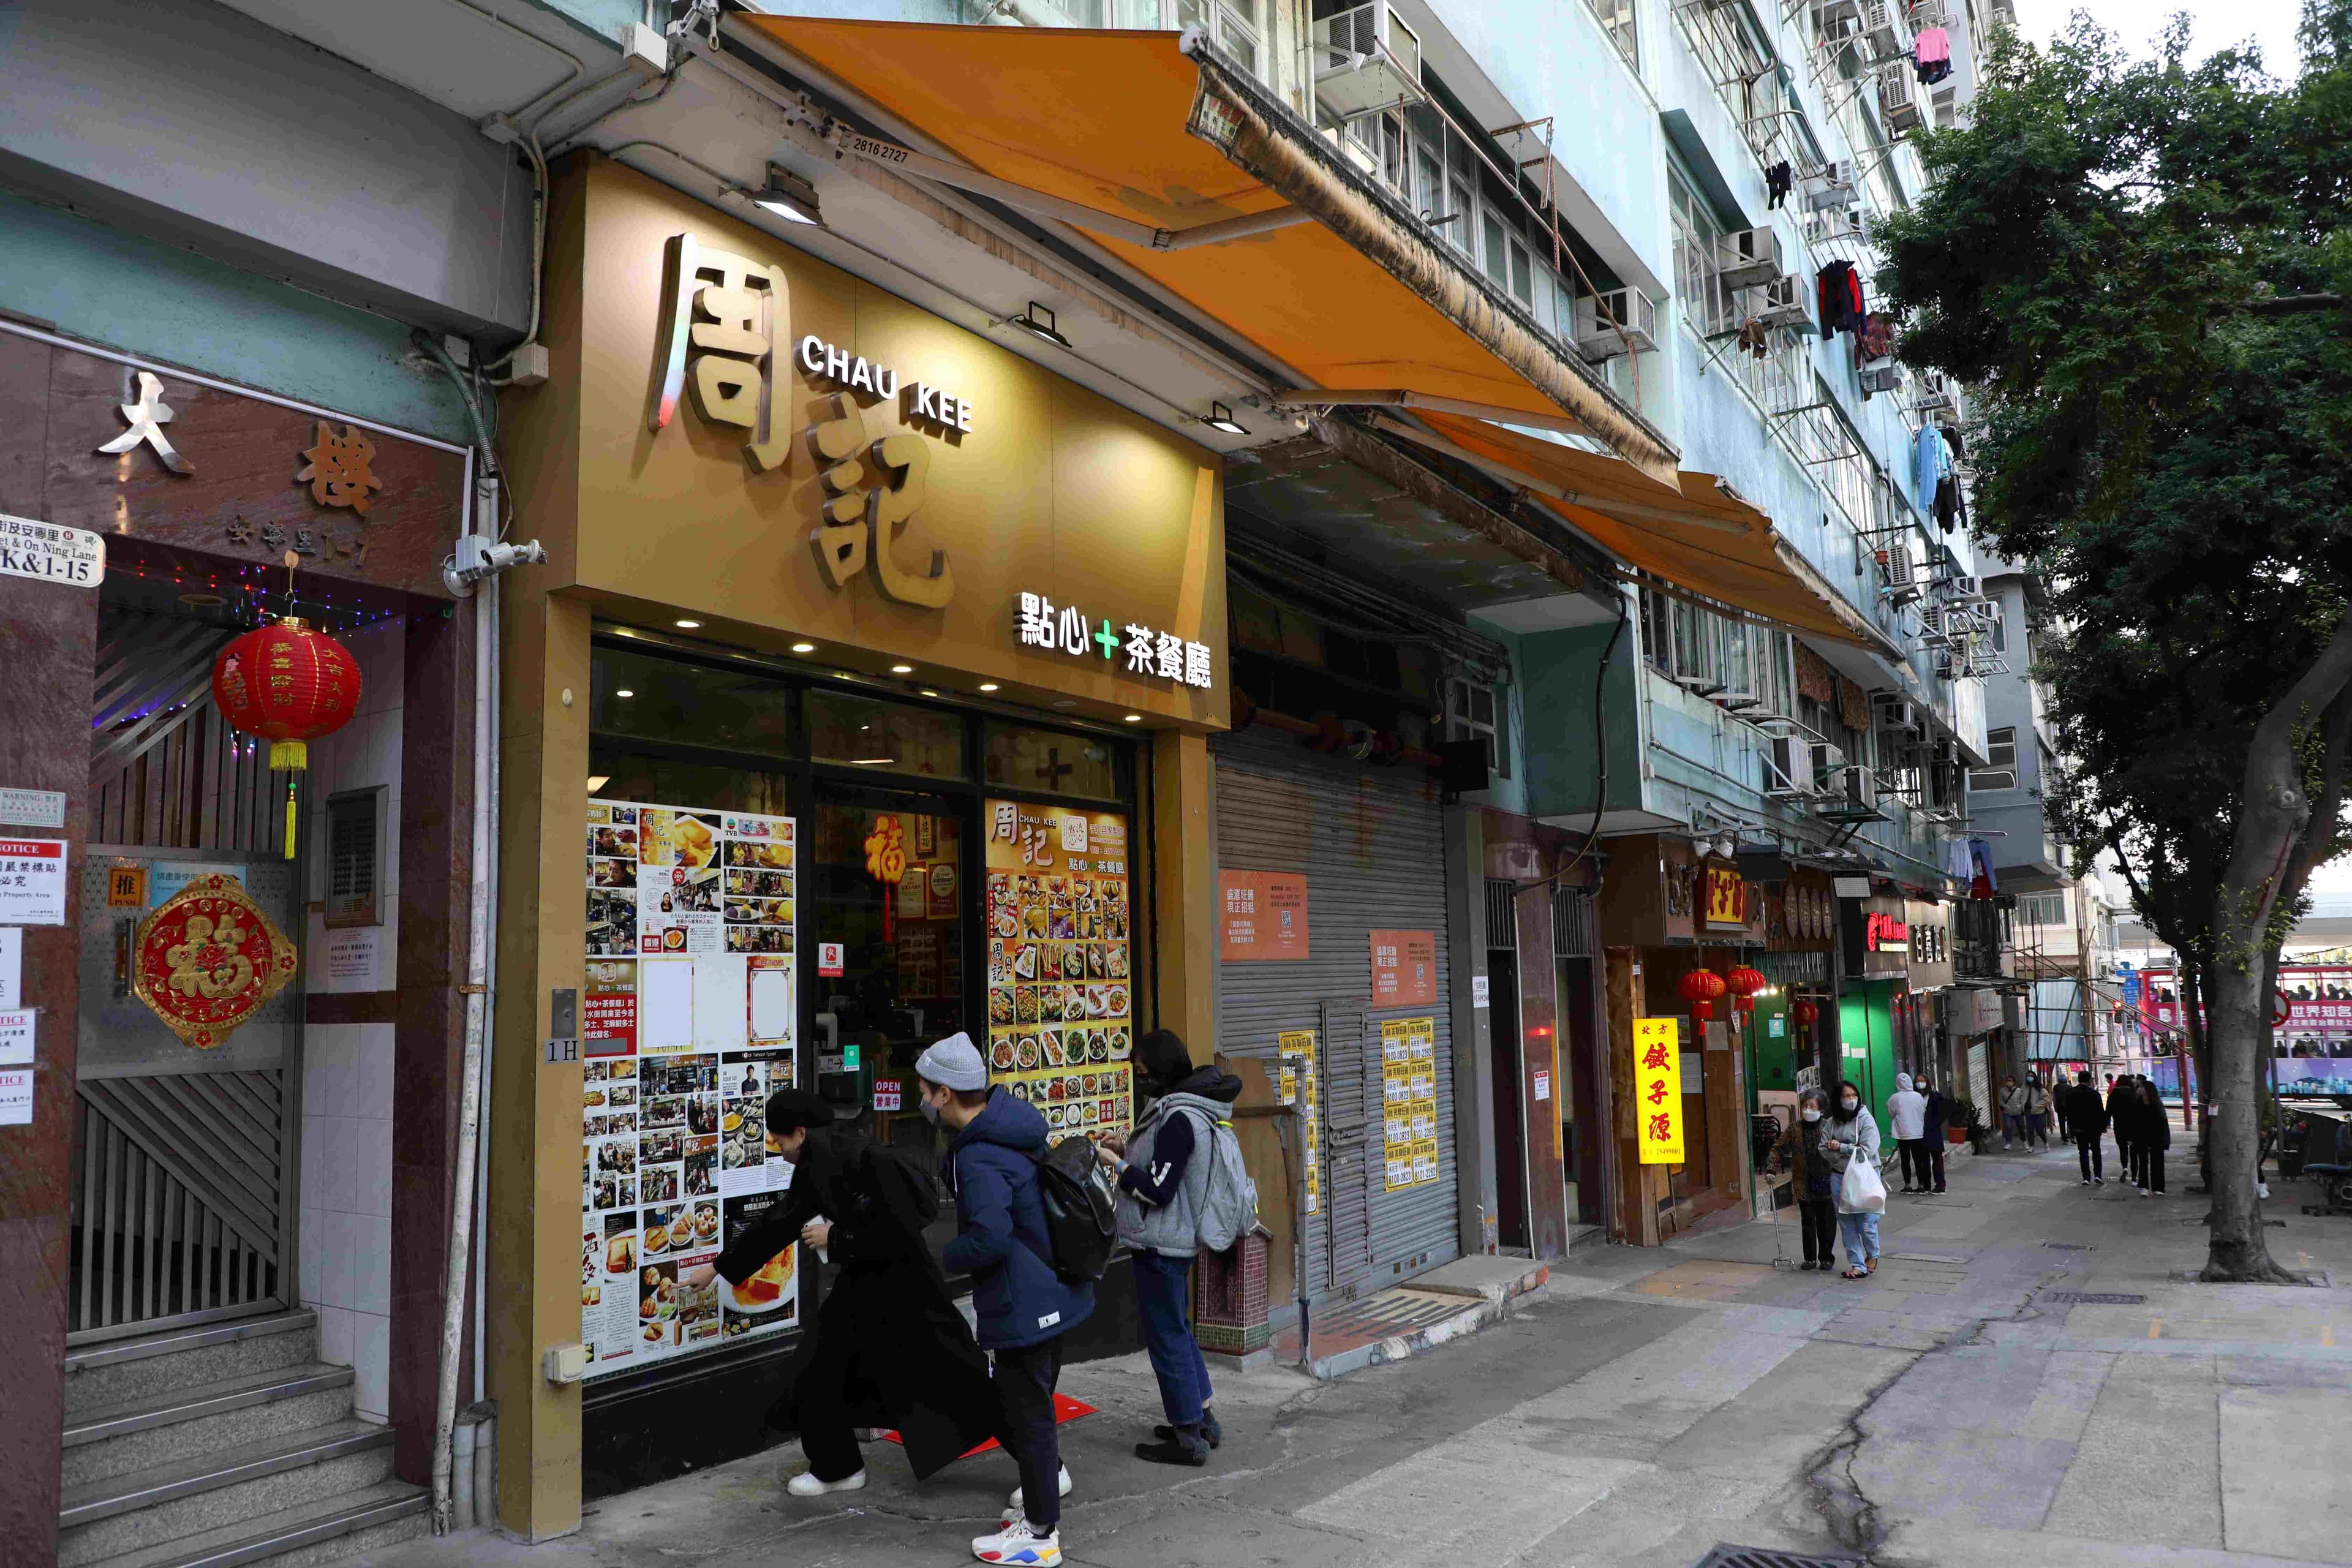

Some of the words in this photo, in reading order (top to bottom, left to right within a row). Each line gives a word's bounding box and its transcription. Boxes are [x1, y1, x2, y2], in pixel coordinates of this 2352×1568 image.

[853, 138, 880, 156] 2816
[881, 149, 908, 164] 2727
[801, 335, 897, 400] CHAU
[918, 383, 973, 434] KEE
[24, 540, 39, 551] On
[43, 543, 69, 559] Ning
[72, 548, 97, 562] Lane
[1019, 815, 1039, 824] CHAU
[1043, 818, 1057, 827] KEE
[990, 803, 1053, 866] 周記
[0, 844, 39, 854] OTICE
[0, 861, 56, 873] 嚴禁標貼
[116, 875, 135, 895] 推
[2291, 1005, 2352, 1017] 世界知名
[1642, 1024, 1667, 1035] 北方
[875, 1082, 900, 1091] OPEN
[875, 1096, 900, 1108] 營業中
[1656, 1147, 1681, 1156] 25499001
